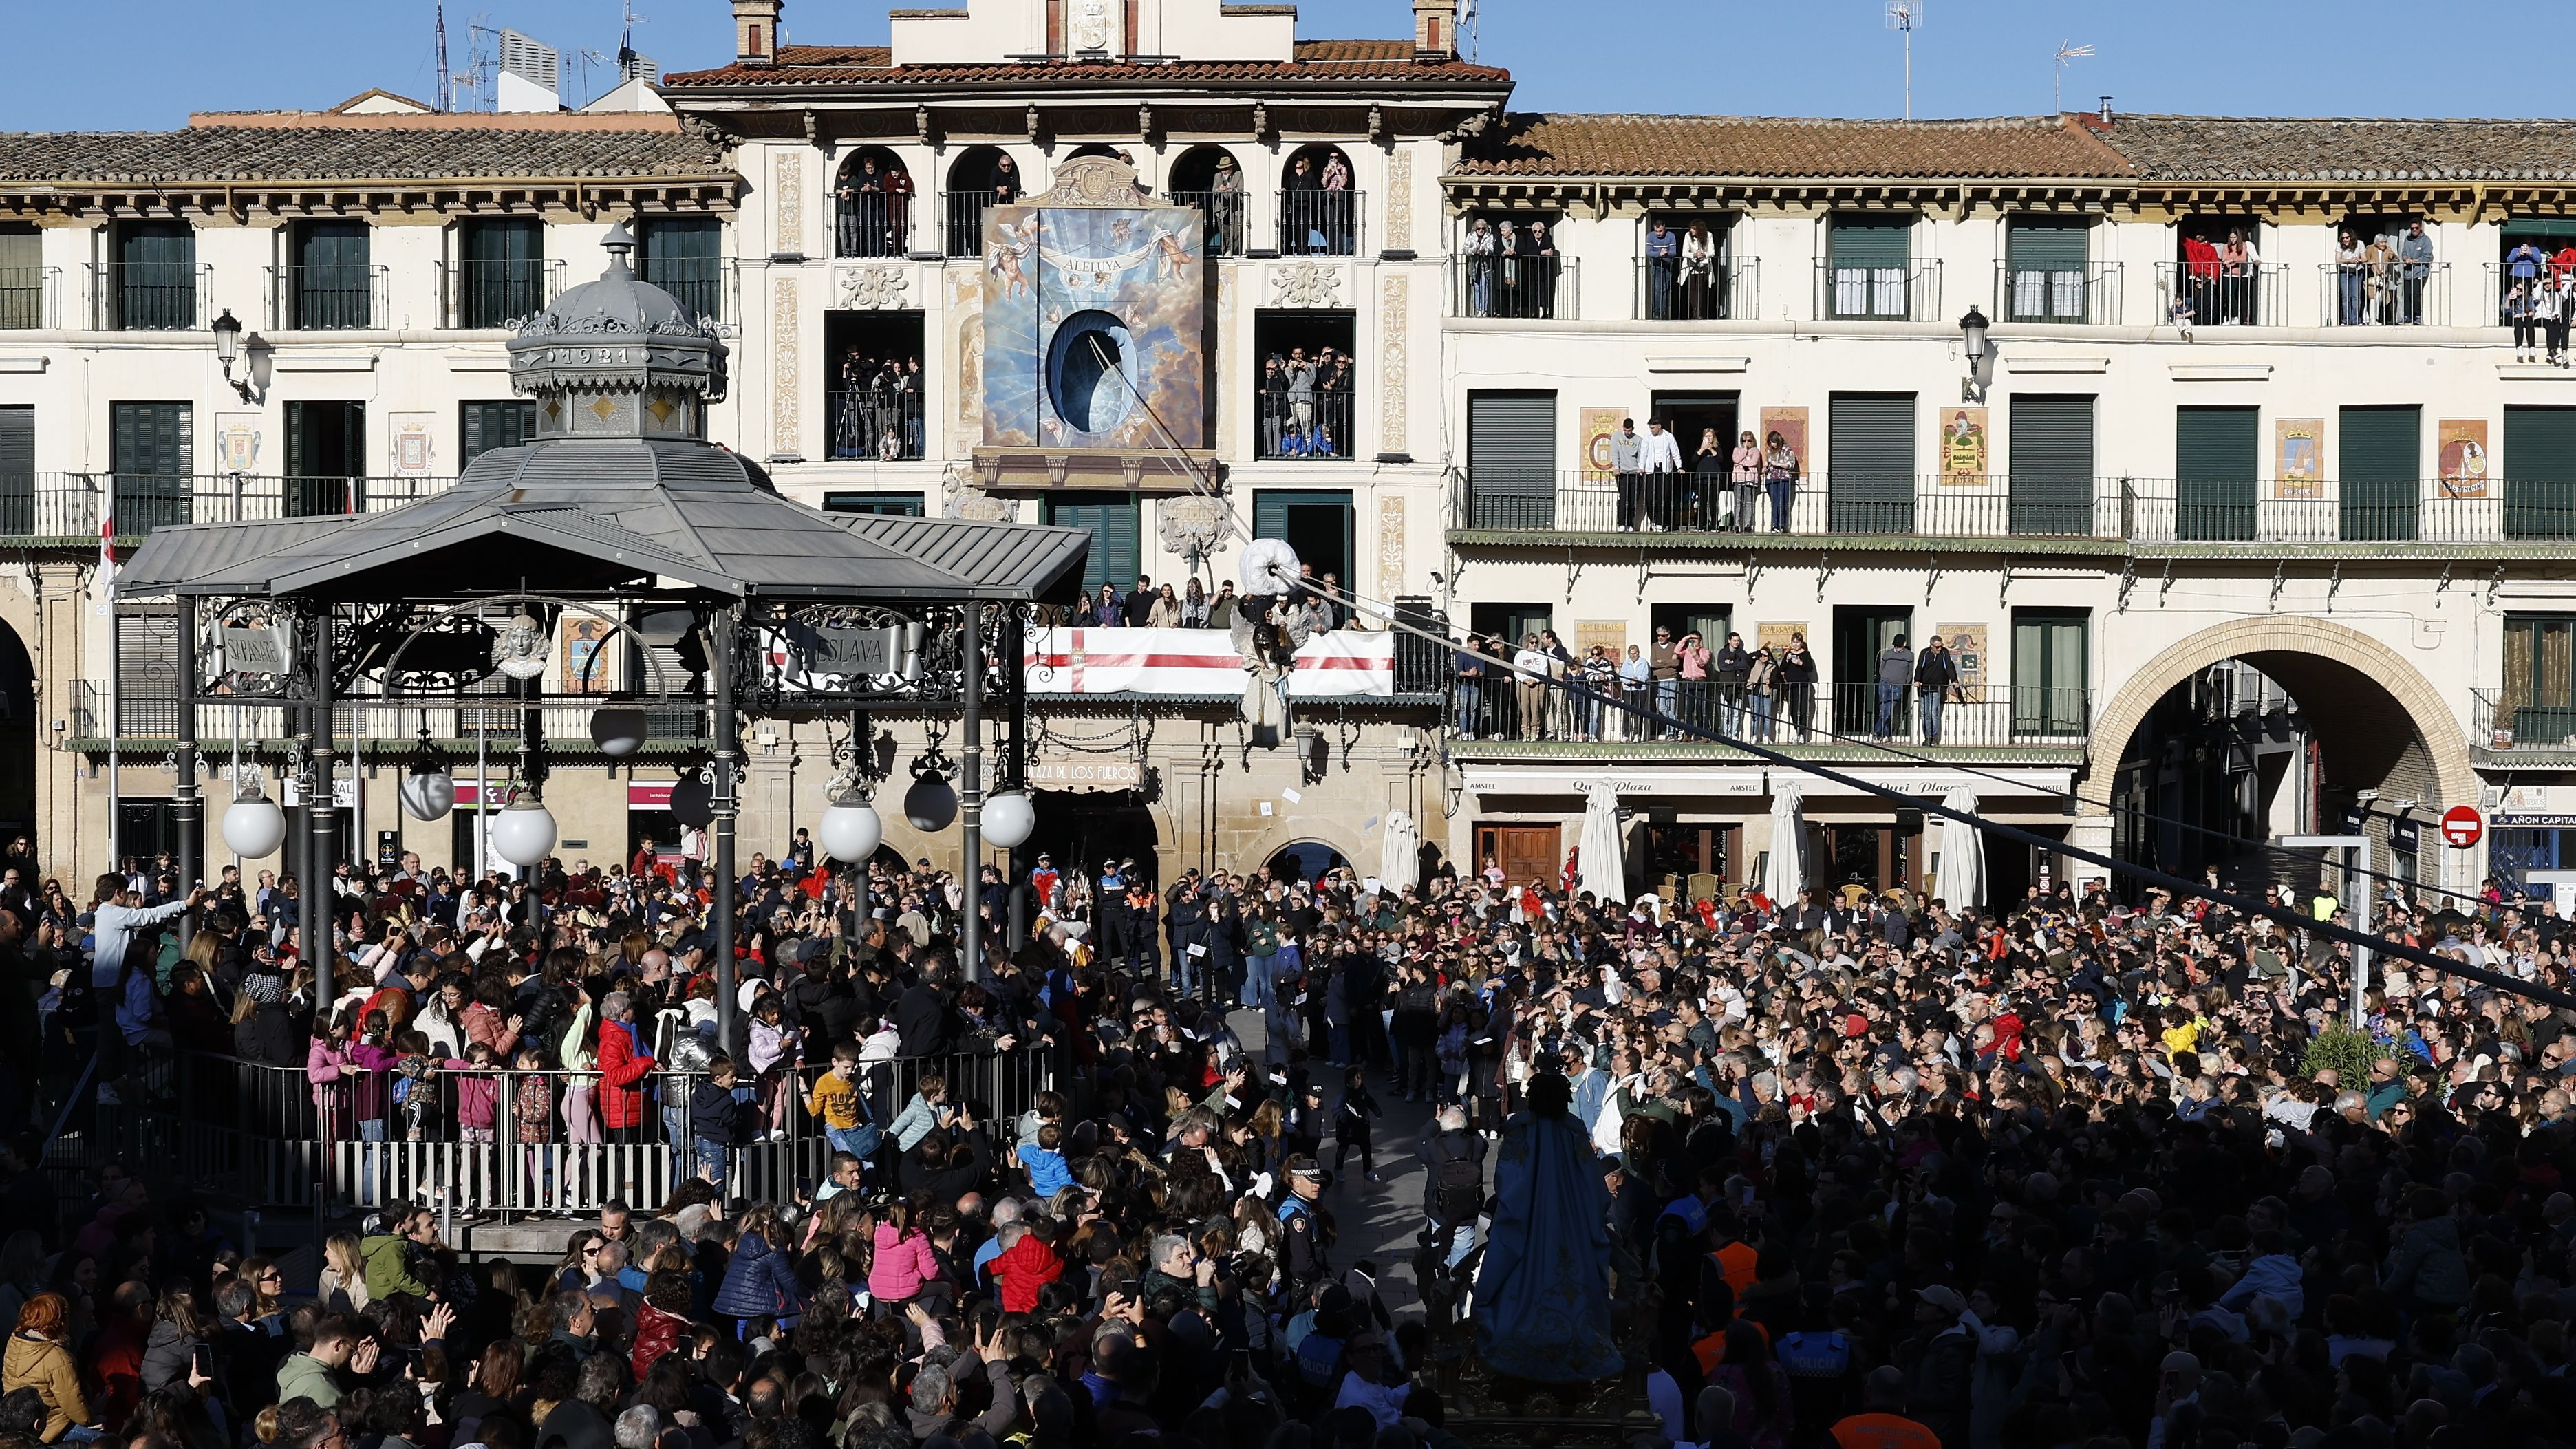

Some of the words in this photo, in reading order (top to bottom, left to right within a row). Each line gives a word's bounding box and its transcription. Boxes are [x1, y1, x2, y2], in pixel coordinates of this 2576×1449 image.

[1064, 259, 1121, 272] ALELUYA
[561, 348, 629, 364] 1921
[817, 638, 883, 663] ESLAVA
[1025, 765, 1053, 779] PLAZA
[1056, 765, 1066, 779] DE
[1071, 766, 1094, 780] LOS
[1097, 766, 1137, 780] FUEROS
[1572, 780, 1591, 792] Qu
[1615, 780, 1652, 792] Plaza
[1918, 782, 1953, 793] Plaz
[2511, 815, 2540, 824] AÑON
